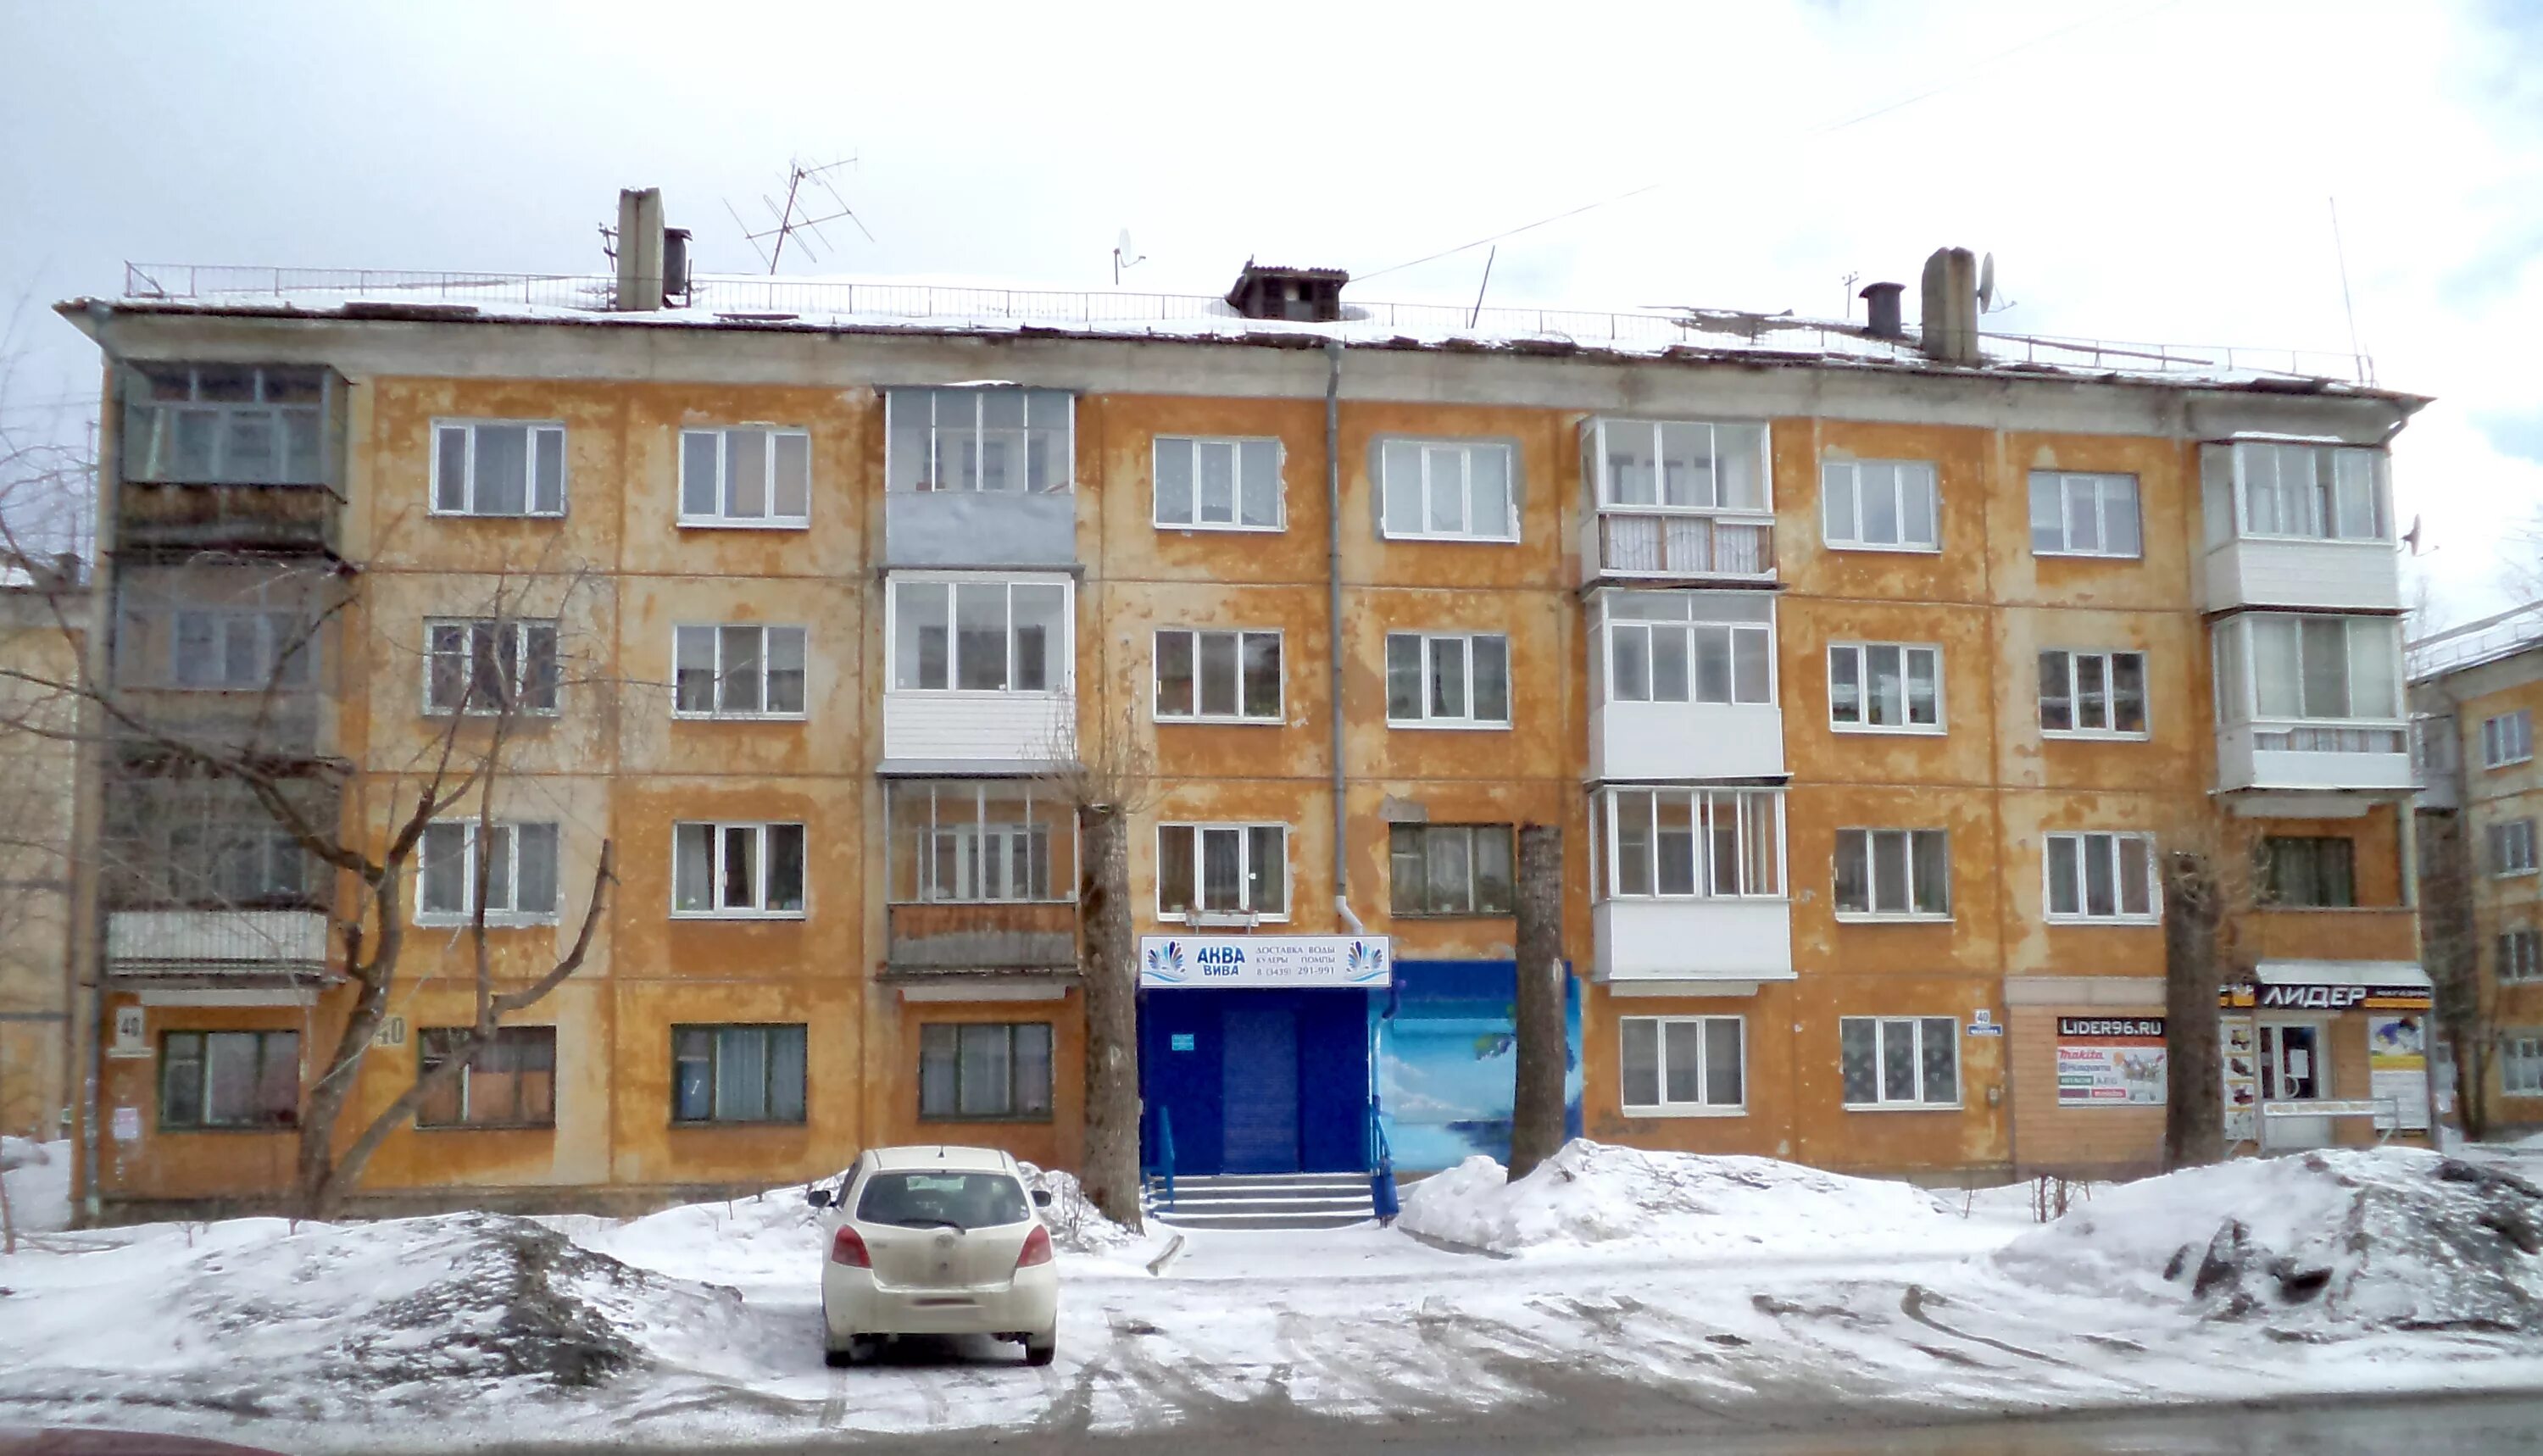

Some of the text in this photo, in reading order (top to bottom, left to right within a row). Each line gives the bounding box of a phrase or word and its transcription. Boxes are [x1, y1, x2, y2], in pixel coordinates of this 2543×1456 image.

[1197, 947, 1245, 964] АКВА
[1255, 946, 1336, 954] ДОСТАВКА ВОДЫ
[1203, 964, 1239, 976] ВИВА
[1298, 966, 1335, 975] 291-991
[2263, 986, 2368, 1009] ЛИДЕР
[1977, 1011, 1989, 1023] 40
